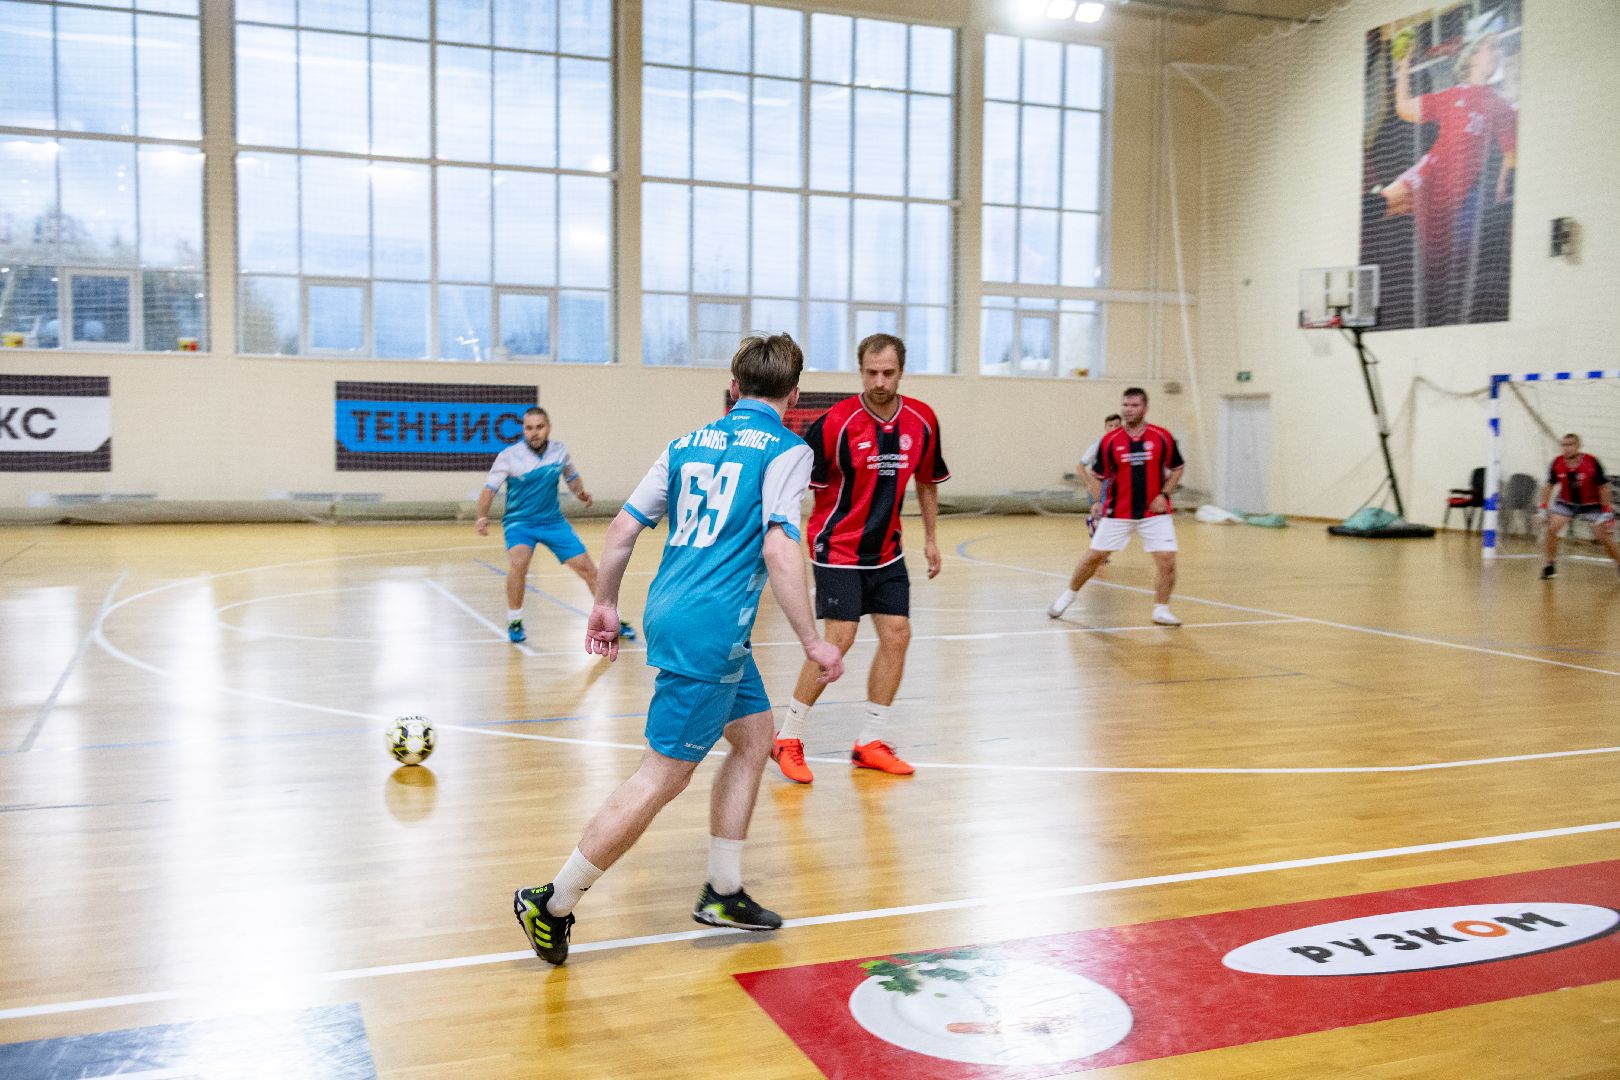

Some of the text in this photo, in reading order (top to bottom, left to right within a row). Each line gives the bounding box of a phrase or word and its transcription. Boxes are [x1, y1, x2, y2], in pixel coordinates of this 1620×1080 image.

[352, 410, 524, 444] ТЕННИС
[668, 461, 743, 548] 69
[1288, 911, 1568, 964] РУЗКОМ
